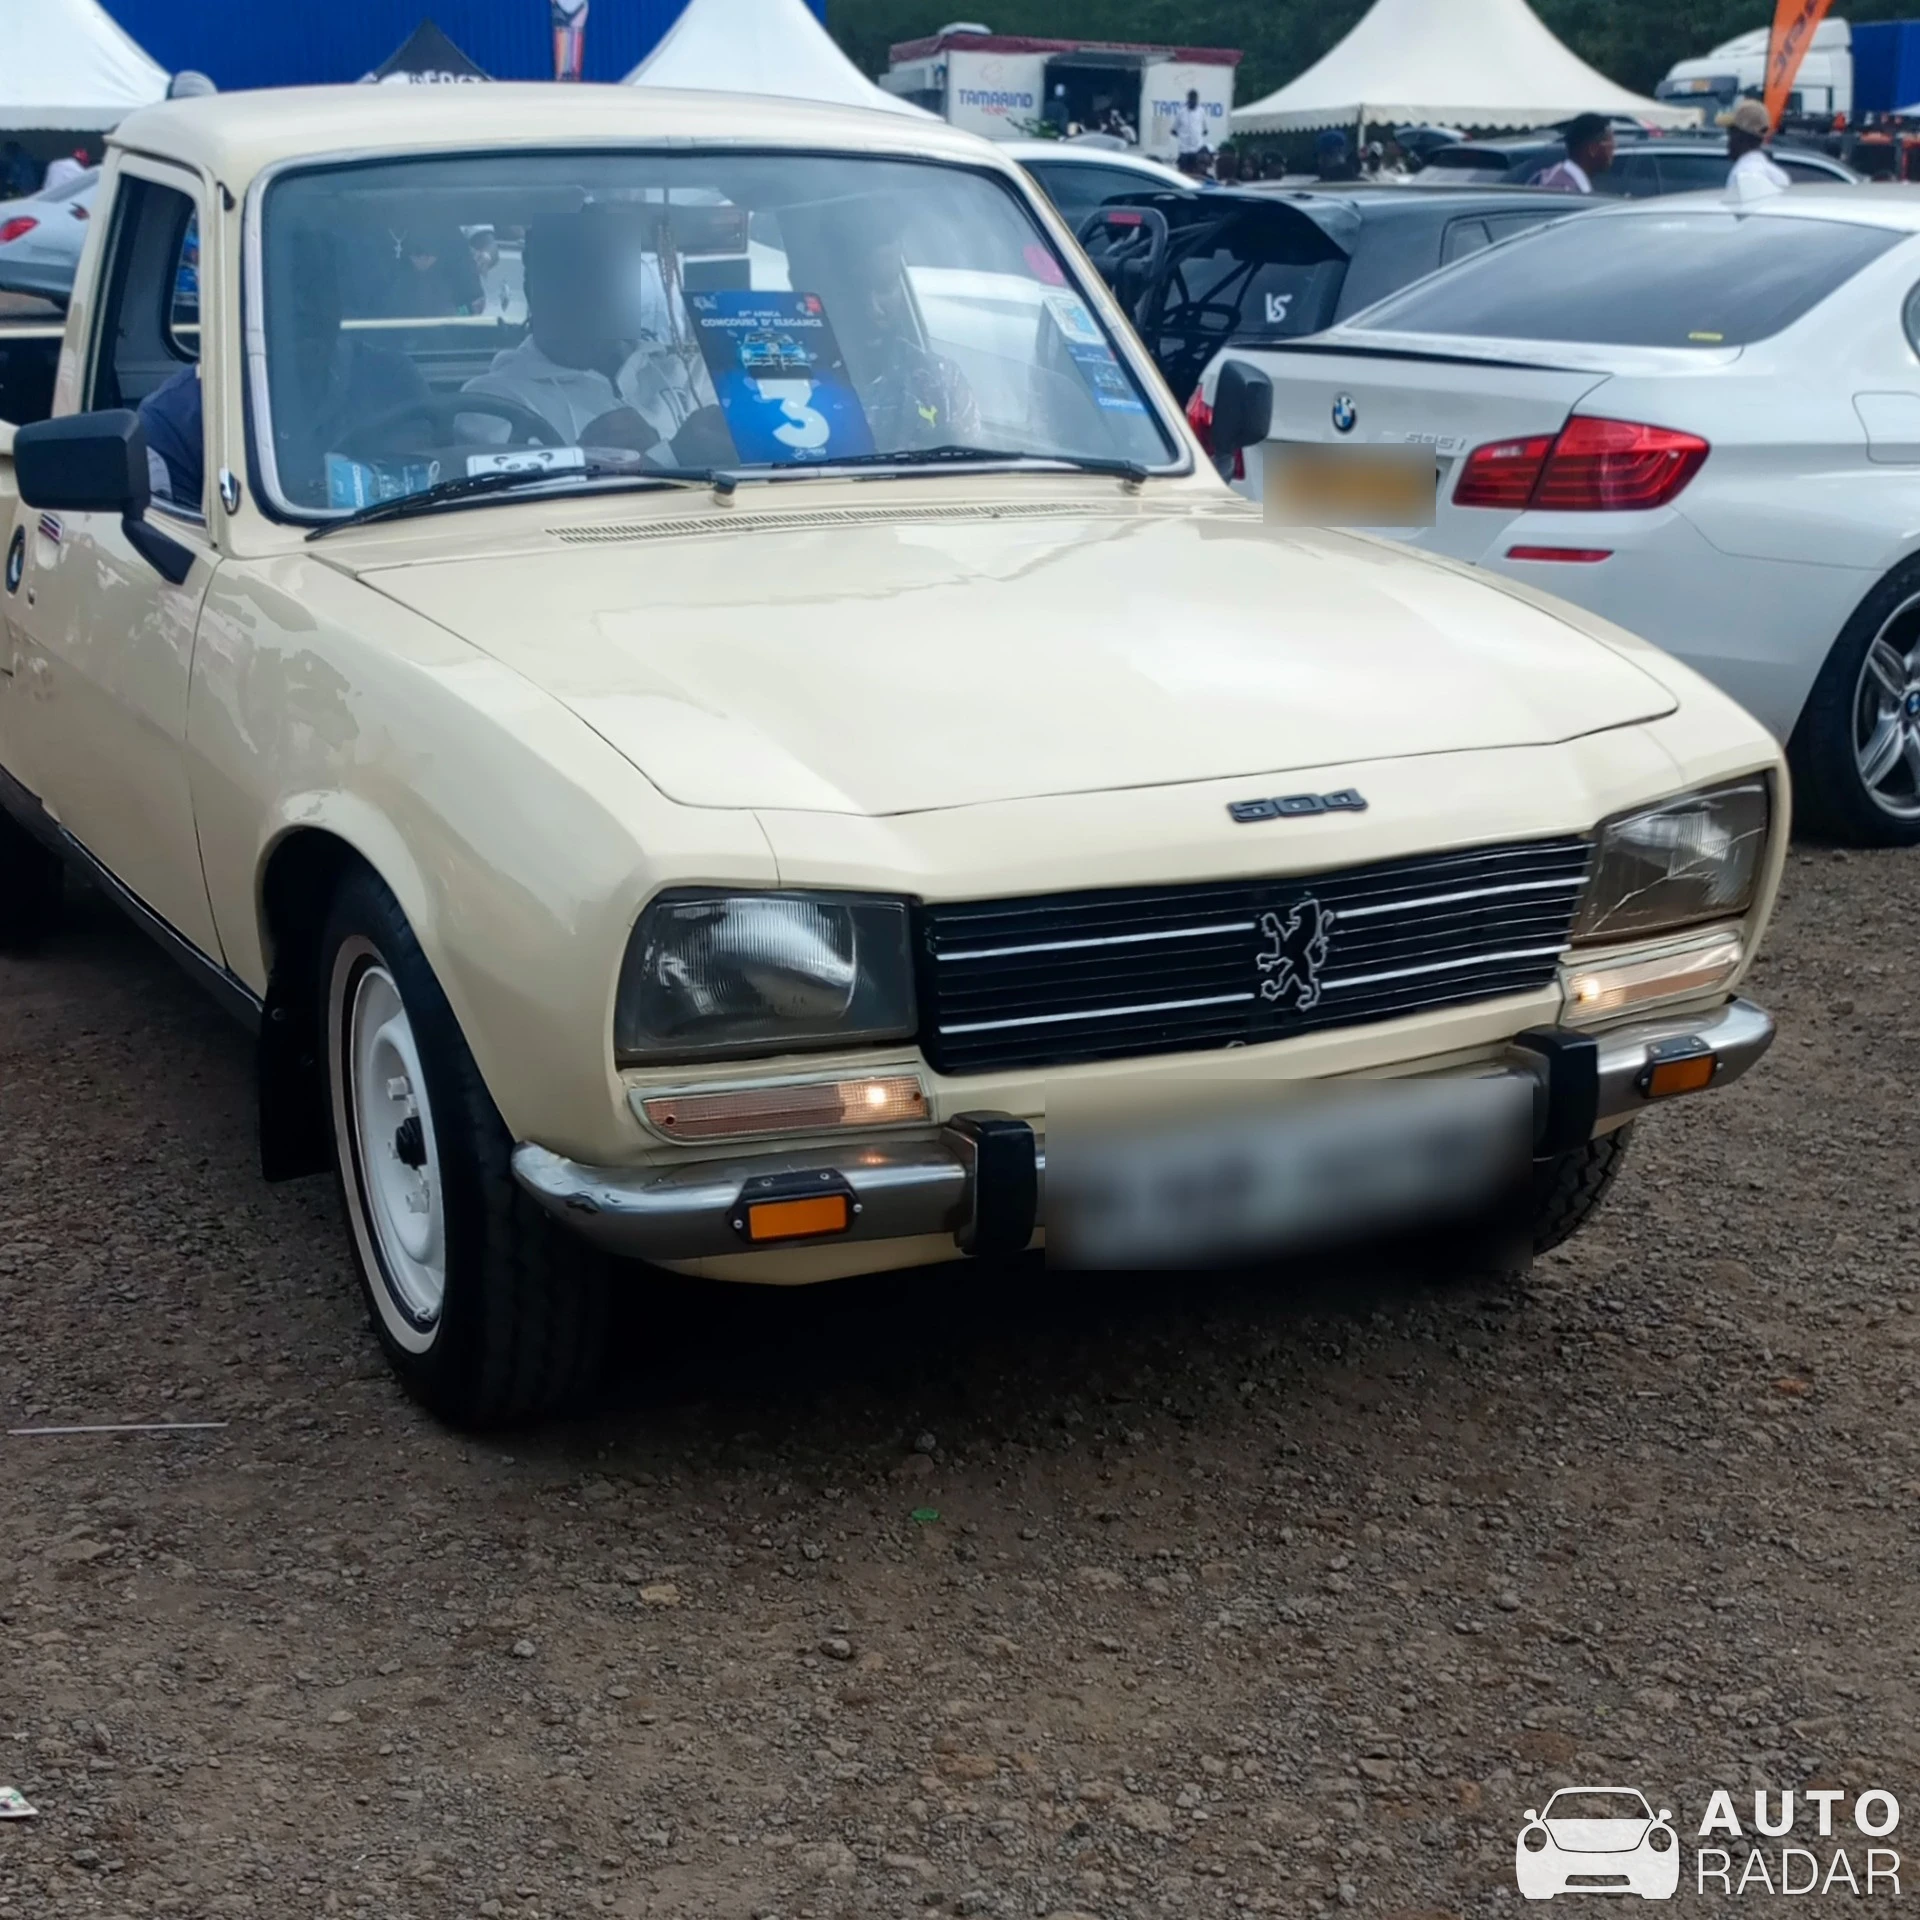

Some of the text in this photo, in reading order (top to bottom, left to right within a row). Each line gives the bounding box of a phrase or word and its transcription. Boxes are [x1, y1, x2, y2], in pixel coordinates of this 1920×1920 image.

[958, 88, 1033, 108] TAMARIND
[756, 379, 830, 449] 3
[1227, 788, 1369, 823] 504
